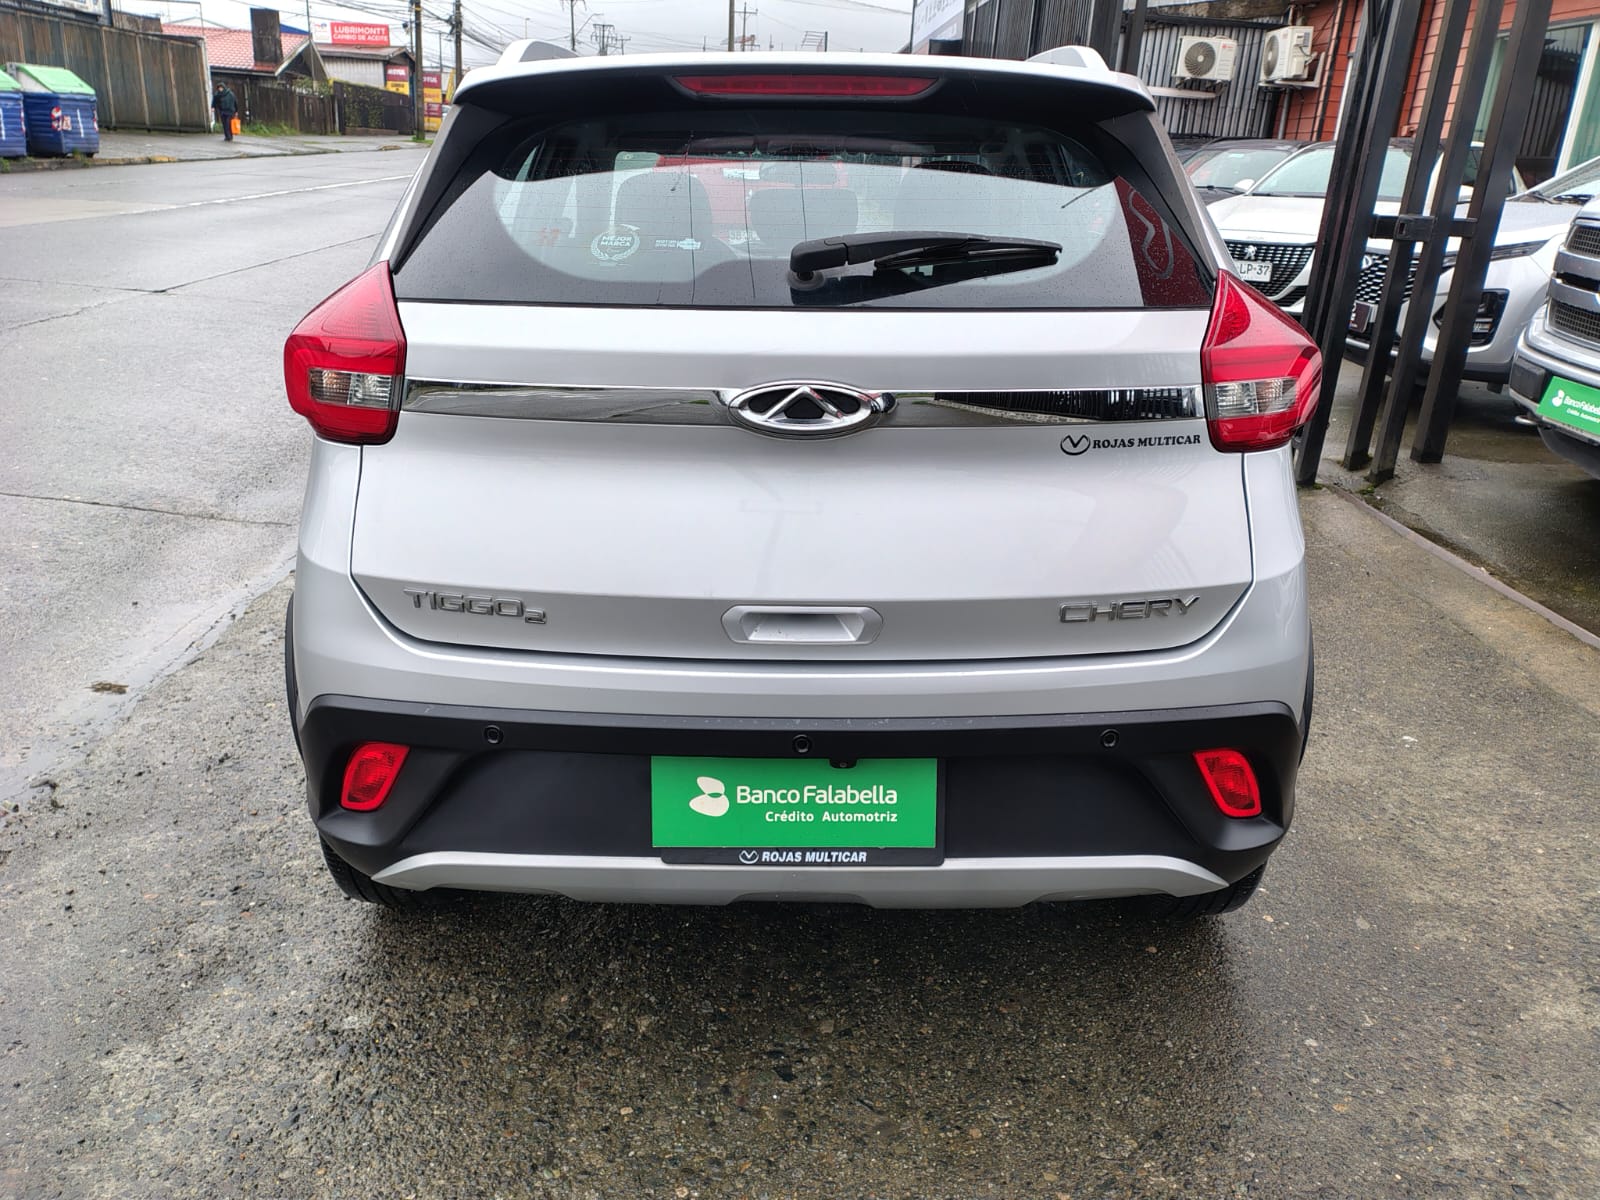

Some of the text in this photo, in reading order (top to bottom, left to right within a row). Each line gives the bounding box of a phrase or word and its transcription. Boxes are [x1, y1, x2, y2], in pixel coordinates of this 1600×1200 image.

[334, 25, 386, 35] LUBRIMONTT
[1092, 434, 1201, 449] ROJAS MULTICAR
[1059, 594, 1201, 623] CHERY
[736, 784, 898, 805] Banco Falabella
[765, 810, 898, 822] Crédito Automotriz
[762, 851, 867, 863] ROJAS MULTICAR
